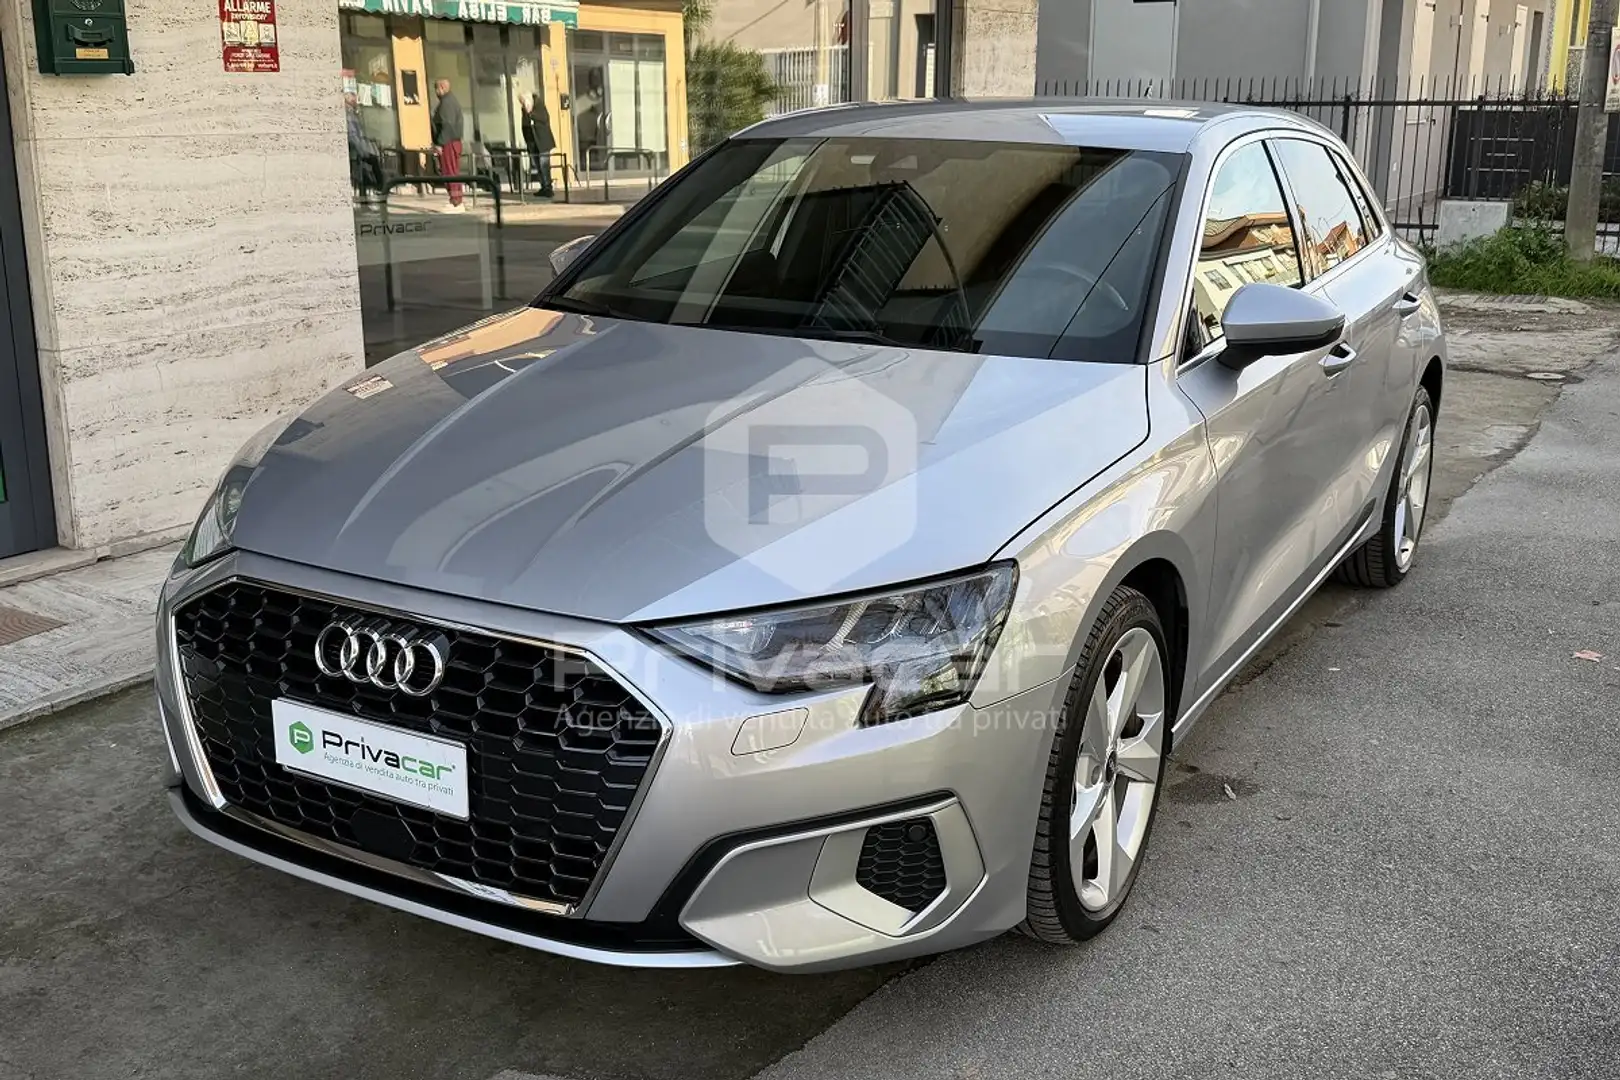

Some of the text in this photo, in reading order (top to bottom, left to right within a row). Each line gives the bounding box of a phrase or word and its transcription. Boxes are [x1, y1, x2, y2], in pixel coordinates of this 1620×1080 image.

[224, 0, 271, 13] ALLARME
[360, 220, 432, 236] Privacar
[321, 730, 453, 780] Privacar
[324, 752, 454, 796] Agenzia di vendita auto tra privati
